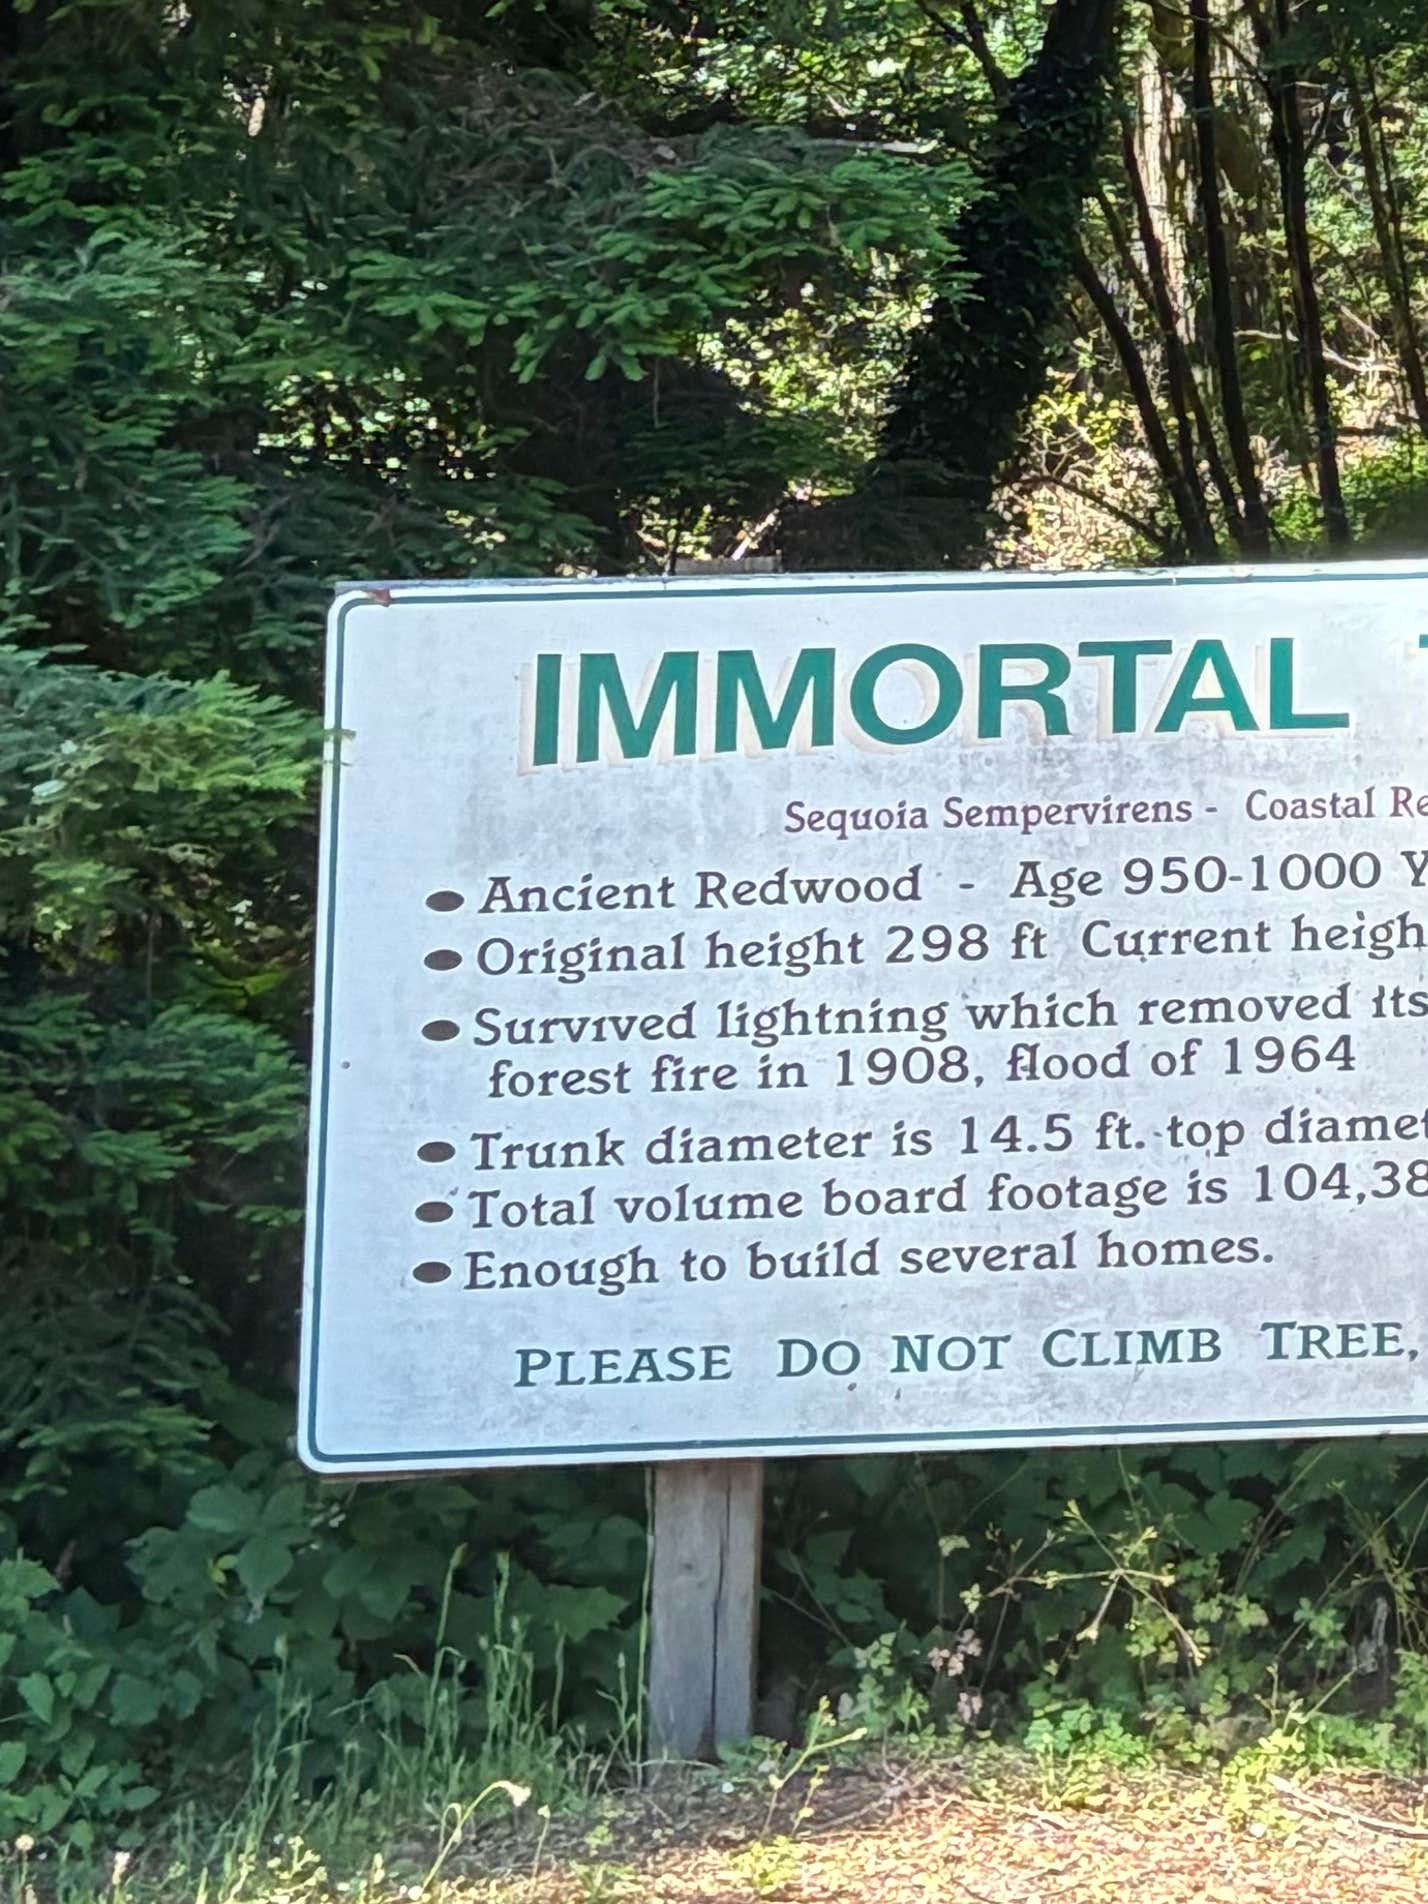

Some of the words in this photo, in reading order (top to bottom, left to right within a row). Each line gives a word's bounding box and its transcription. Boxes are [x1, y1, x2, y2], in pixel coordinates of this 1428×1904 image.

[532, 637, 1350, 767] IMMORTAL
[784, 799, 929, 841] Sequoia
[943, 796, 1193, 836] Sempervirens
[1245, 785, 1377, 822] Coastal
[477, 872, 676, 914] Ancient
[694, 863, 923, 910] Redwood
[1009, 860, 1103, 909] Age
[1123, 851, 1382, 896] 950-1000
[476, 931, 686, 985] Original
[704, 926, 865, 978] height
[885, 923, 989, 964] 298
[1010, 921, 1048, 960] ft
[1081, 919, 1272, 958] Current
[473, 1000, 697, 1047] Survived
[716, 997, 950, 1049] lightning
[964, 988, 1119, 1030] which
[1138, 981, 1352, 1026] removed
[487, 1059, 632, 1099] forest
[650, 1053, 739, 1093] fire
[757, 1053, 809, 1090] in
[836, 1045, 985, 1089] 1908,
[1005, 1039, 1131, 1082] flood
[1150, 1037, 1203, 1077] of
[1224, 1034, 1356, 1075] 1964
[469, 1127, 626, 1171] Trunk
[645, 1125, 873, 1165] diameter
[891, 1119, 933, 1157] is
[960, 1112, 1073, 1155] 14.5
[1095, 1111, 1146, 1151] ft.
[1166, 1114, 1245, 1158] top
[467, 1185, 596, 1229] Total
[613, 1183, 803, 1224] volume
[821, 1173, 968, 1217] board
[987, 1172, 1168, 1219] footage
[1186, 1168, 1228, 1205] is
[463, 1244, 660, 1297] Enough
[679, 1248, 727, 1283] to
[746, 1236, 880, 1280] build
[899, 1230, 1078, 1275] several
[1097, 1229, 1274, 1268] homes.
[513, 1344, 733, 1388] PLEASE
[776, 1338, 861, 1378] DO
[890, 1334, 1012, 1374] NOT
[1042, 1328, 1222, 1368] CLIMB
[1259, 1320, 1419, 1362] TREE,
